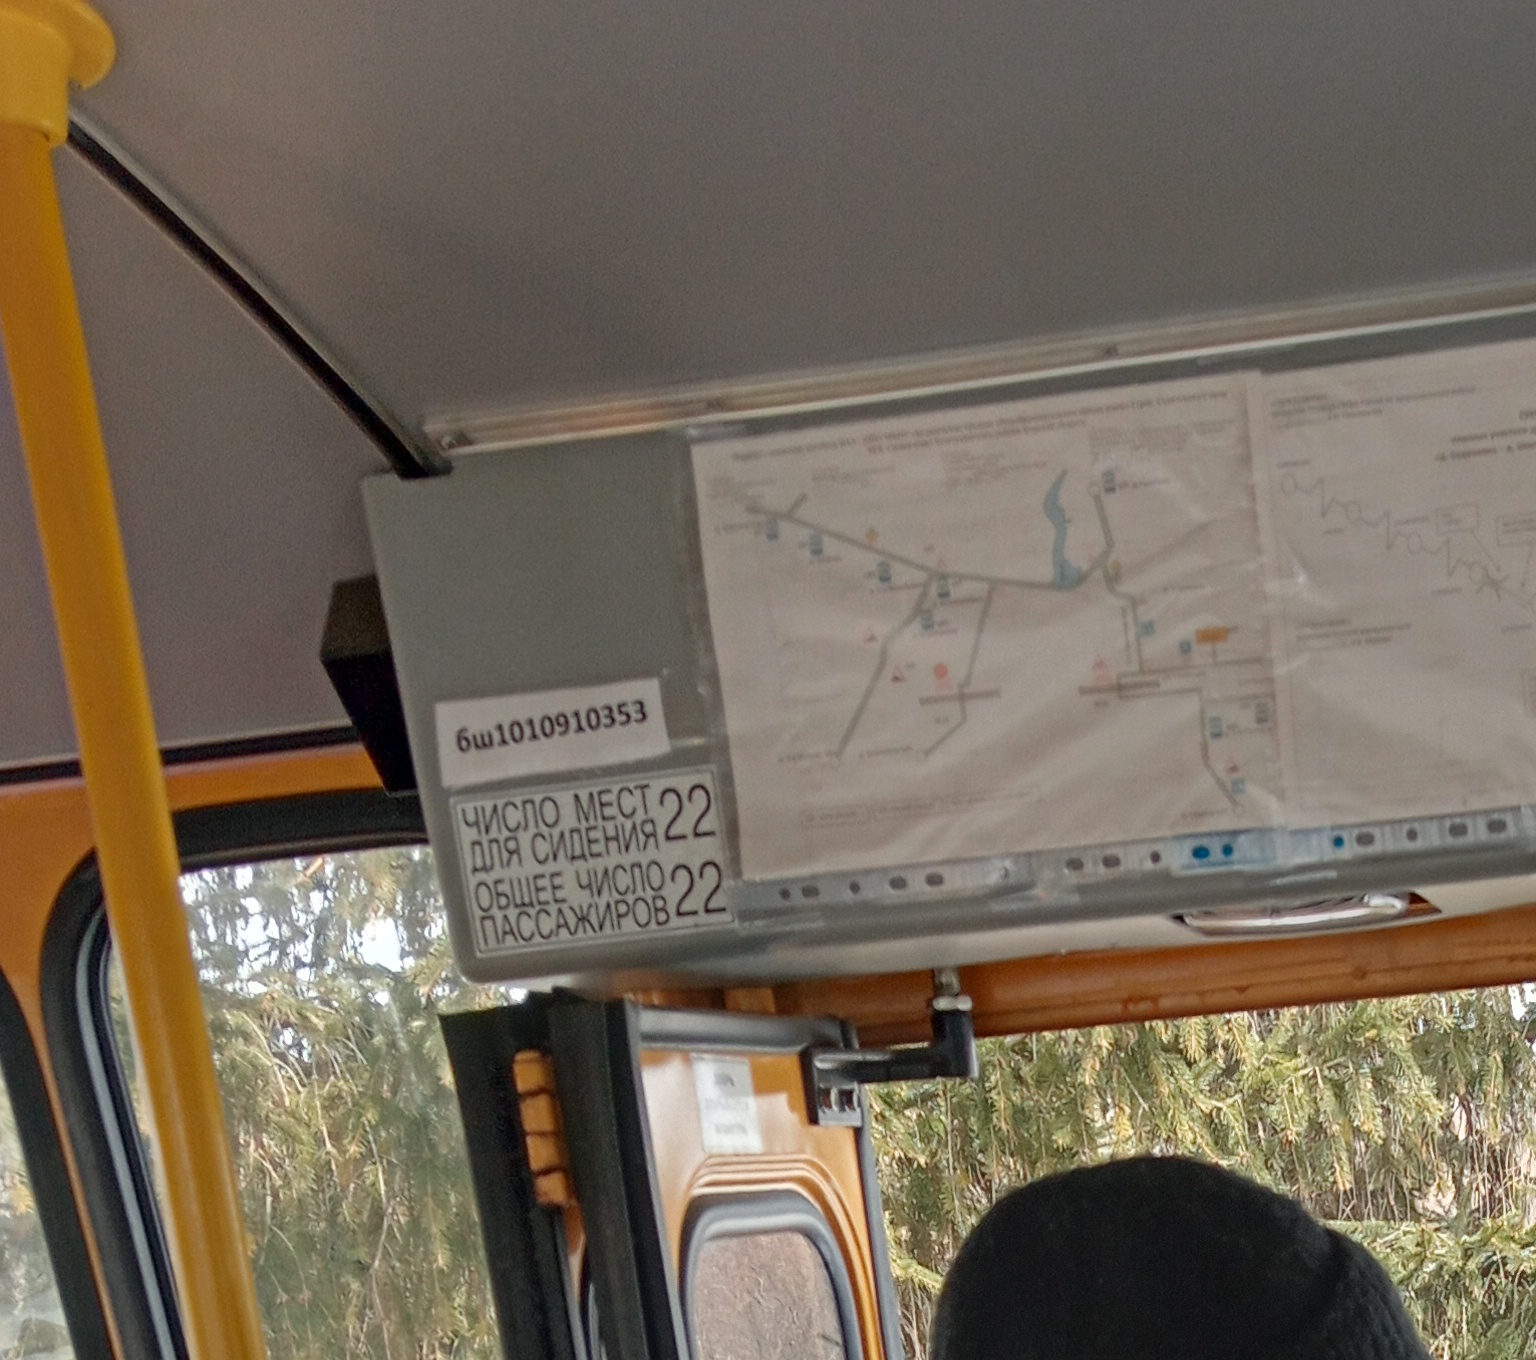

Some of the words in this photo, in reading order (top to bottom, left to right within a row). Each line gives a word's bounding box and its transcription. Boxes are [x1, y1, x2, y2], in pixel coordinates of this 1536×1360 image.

[461, 796, 560, 837] ЧИСЛО
[573, 785, 651, 826] МЕСТ
[470, 839, 522, 875] ДЛЯ
[531, 818, 659, 864] СИДЕНИЯ
[474, 873, 566, 912] ОБЩЕЕ
[577, 862, 665, 898] ЧИСЛО
[480, 896, 670, 946] ПАССАЖИРОВ
